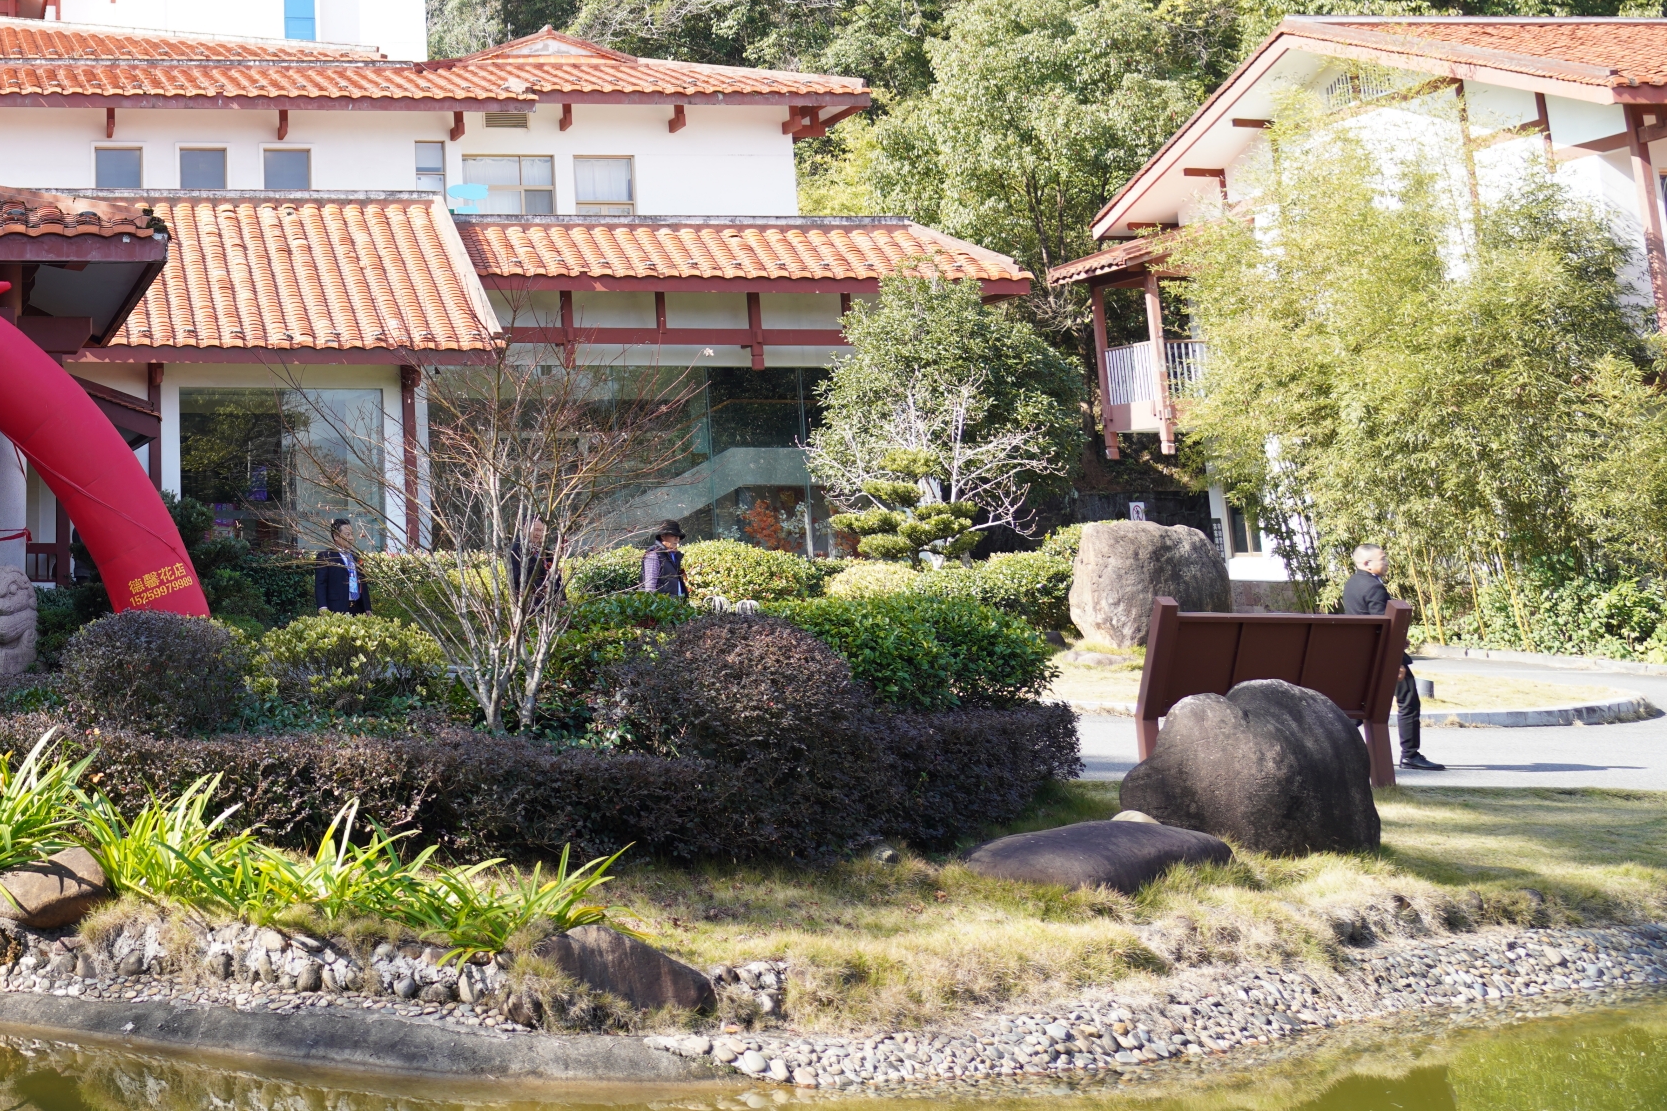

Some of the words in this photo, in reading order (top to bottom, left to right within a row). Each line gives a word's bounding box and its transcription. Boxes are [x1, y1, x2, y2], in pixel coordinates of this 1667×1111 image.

[128, 562, 187, 594] 德馨花店
[130, 575, 193, 607] 15259979989
